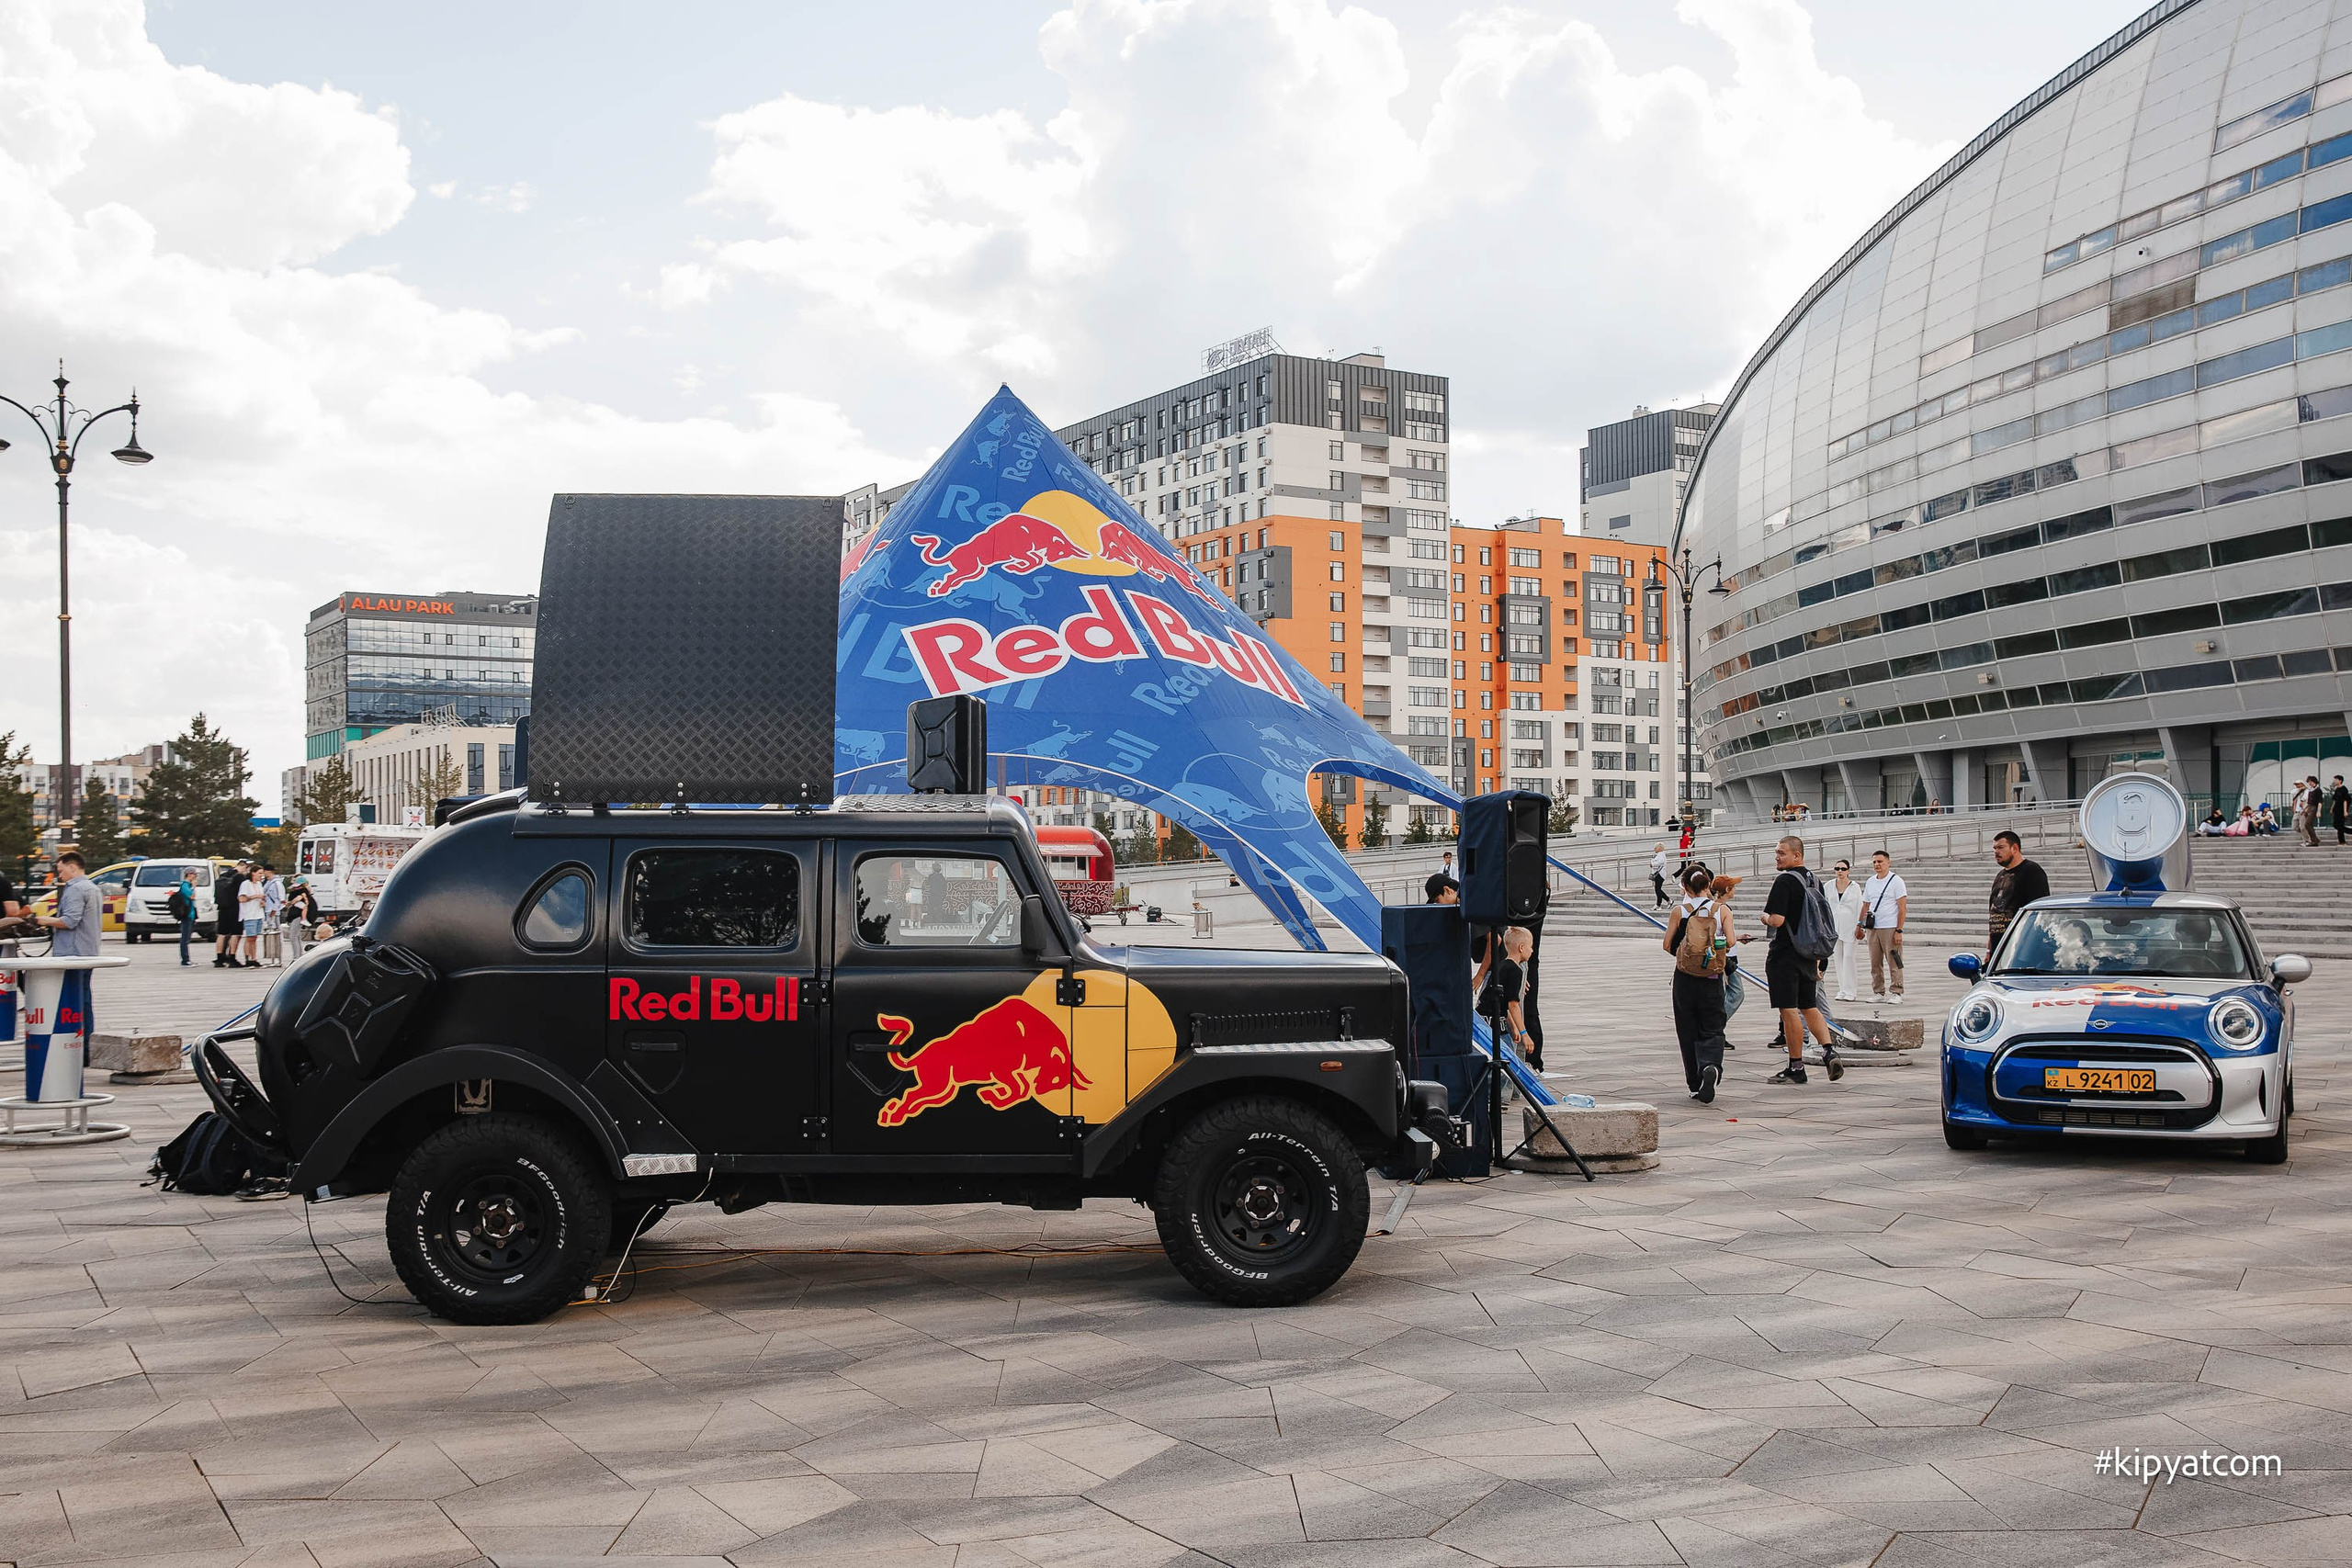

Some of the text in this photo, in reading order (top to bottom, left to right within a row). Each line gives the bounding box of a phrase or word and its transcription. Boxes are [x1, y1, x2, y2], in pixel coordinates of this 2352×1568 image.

[1001, 444, 1040, 483] Red
[350, 596, 456, 616] ALAU PARK
[908, 586, 1138, 698] Red
[1133, 591, 1305, 707] Bull
[1105, 728, 1160, 774] ull
[609, 976, 797, 1021] Red Bull
[2032, 994, 2102, 1009] Red
[2047, 1079, 2059, 1088] KZ
[2065, 1072, 2153, 1090] L 9241 02
[1248, 1132, 1340, 1213] All-Terrain T/A
[516, 1156, 568, 1249] BFGoodrich
[416, 1190, 479, 1298] All-Terrain T/A
[1191, 1213, 1270, 1280] BFGoodrich
